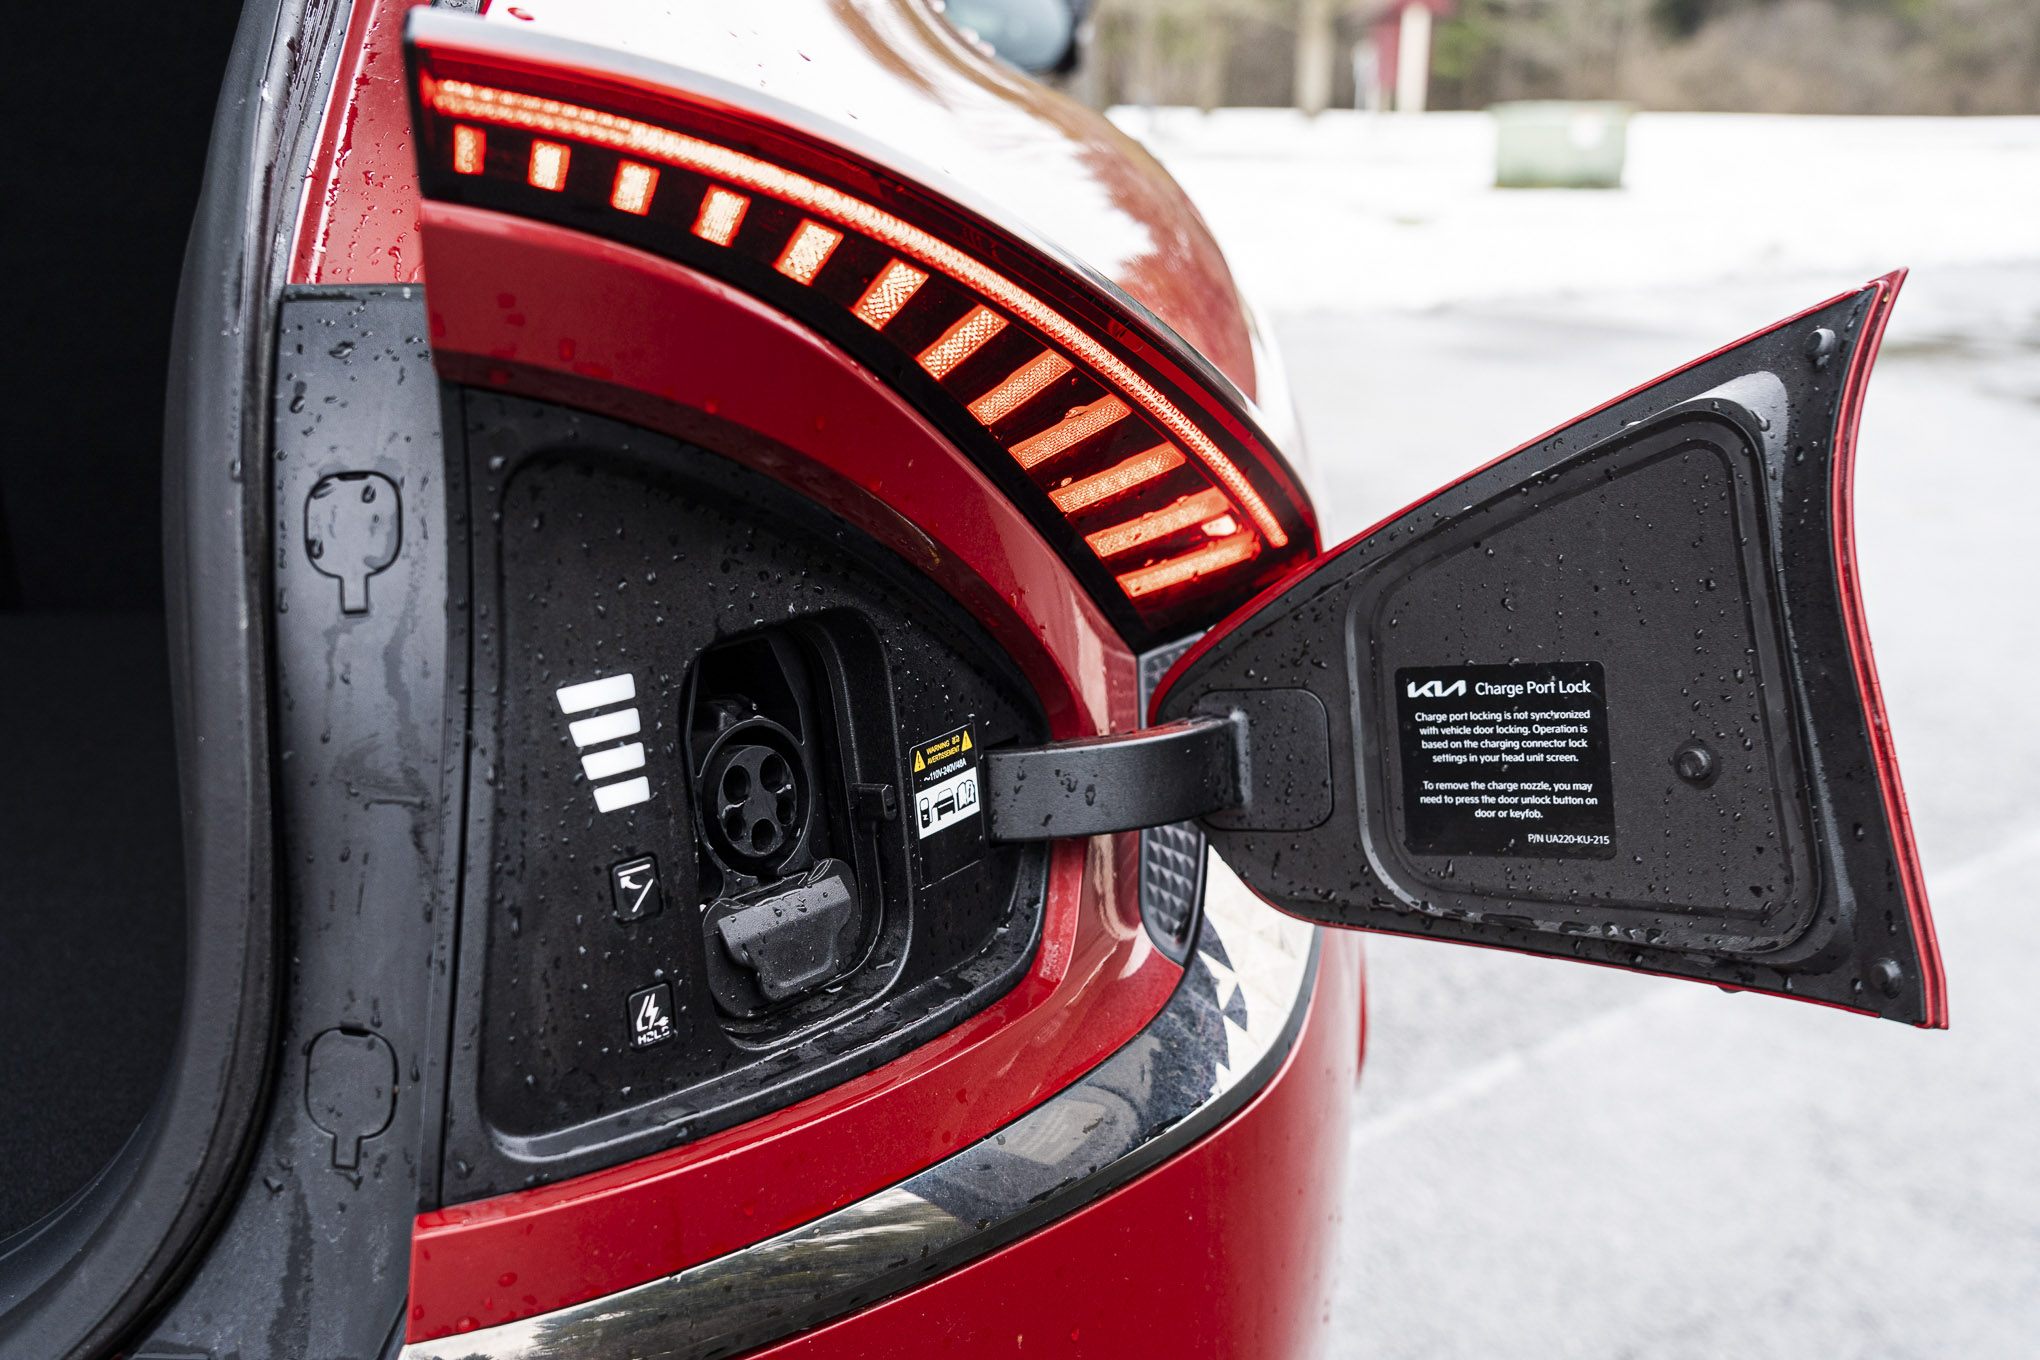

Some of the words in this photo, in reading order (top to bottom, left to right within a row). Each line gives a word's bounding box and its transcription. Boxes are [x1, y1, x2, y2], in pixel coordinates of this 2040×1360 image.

[1475, 682, 1523, 697] Charge
[1527, 680, 1555, 694] Port
[1559, 680, 1591, 693] Lock
[1415, 712, 1447, 723] Charge
[1449, 712, 1468, 722] port
[1470, 712, 1502, 722] locking
[1504, 711, 1512, 720] is
[1513, 711, 1528, 719] not
[1530, 710, 1590, 720] synchronized
[1419, 726, 1439, 735] with
[1440, 726, 1471, 734] vehicle
[1473, 725, 1494, 734] door
[1496, 725, 1531, 735] locking.
[1532, 724, 1578, 735] Operation
[1580, 724, 1588, 733] is
[926, 740, 950, 755] WARNING
[1422, 740, 1448, 748] based
[1464, 740, 1478, 748] the
[1480, 739, 1520, 750] charging
[1521, 739, 1567, 748] connector
[1569, 739, 1588, 747] lock
[927, 745, 960, 765] AVERTISSEMENT
[1433, 754, 1467, 764] settings
[1469, 754, 1478, 762] in
[1479, 755, 1500, 764] your
[1502, 754, 1524, 762] head
[1526, 753, 1544, 761] unit
[1423, 781, 1434, 790] To
[1471, 781, 1486, 790] the
[1487, 781, 1518, 792] charge
[1520, 781, 1551, 791] nozzle,
[1553, 783, 1571, 792] you
[1573, 783, 1592, 792] may
[1420, 795, 1442, 803] need
[1444, 795, 1453, 803] to
[1455, 797, 1479, 805] press
[1481, 795, 1496, 804] the
[1498, 795, 1519, 804] door
[1521, 795, 1551, 804] unlock
[1553, 796, 1584, 804] button
[1475, 809, 1496, 817] door
[1510, 809, 1543, 820] keyfob.
[1528, 834, 1544, 843] P/N
[1546, 835, 1610, 844] UA220-KU-215
